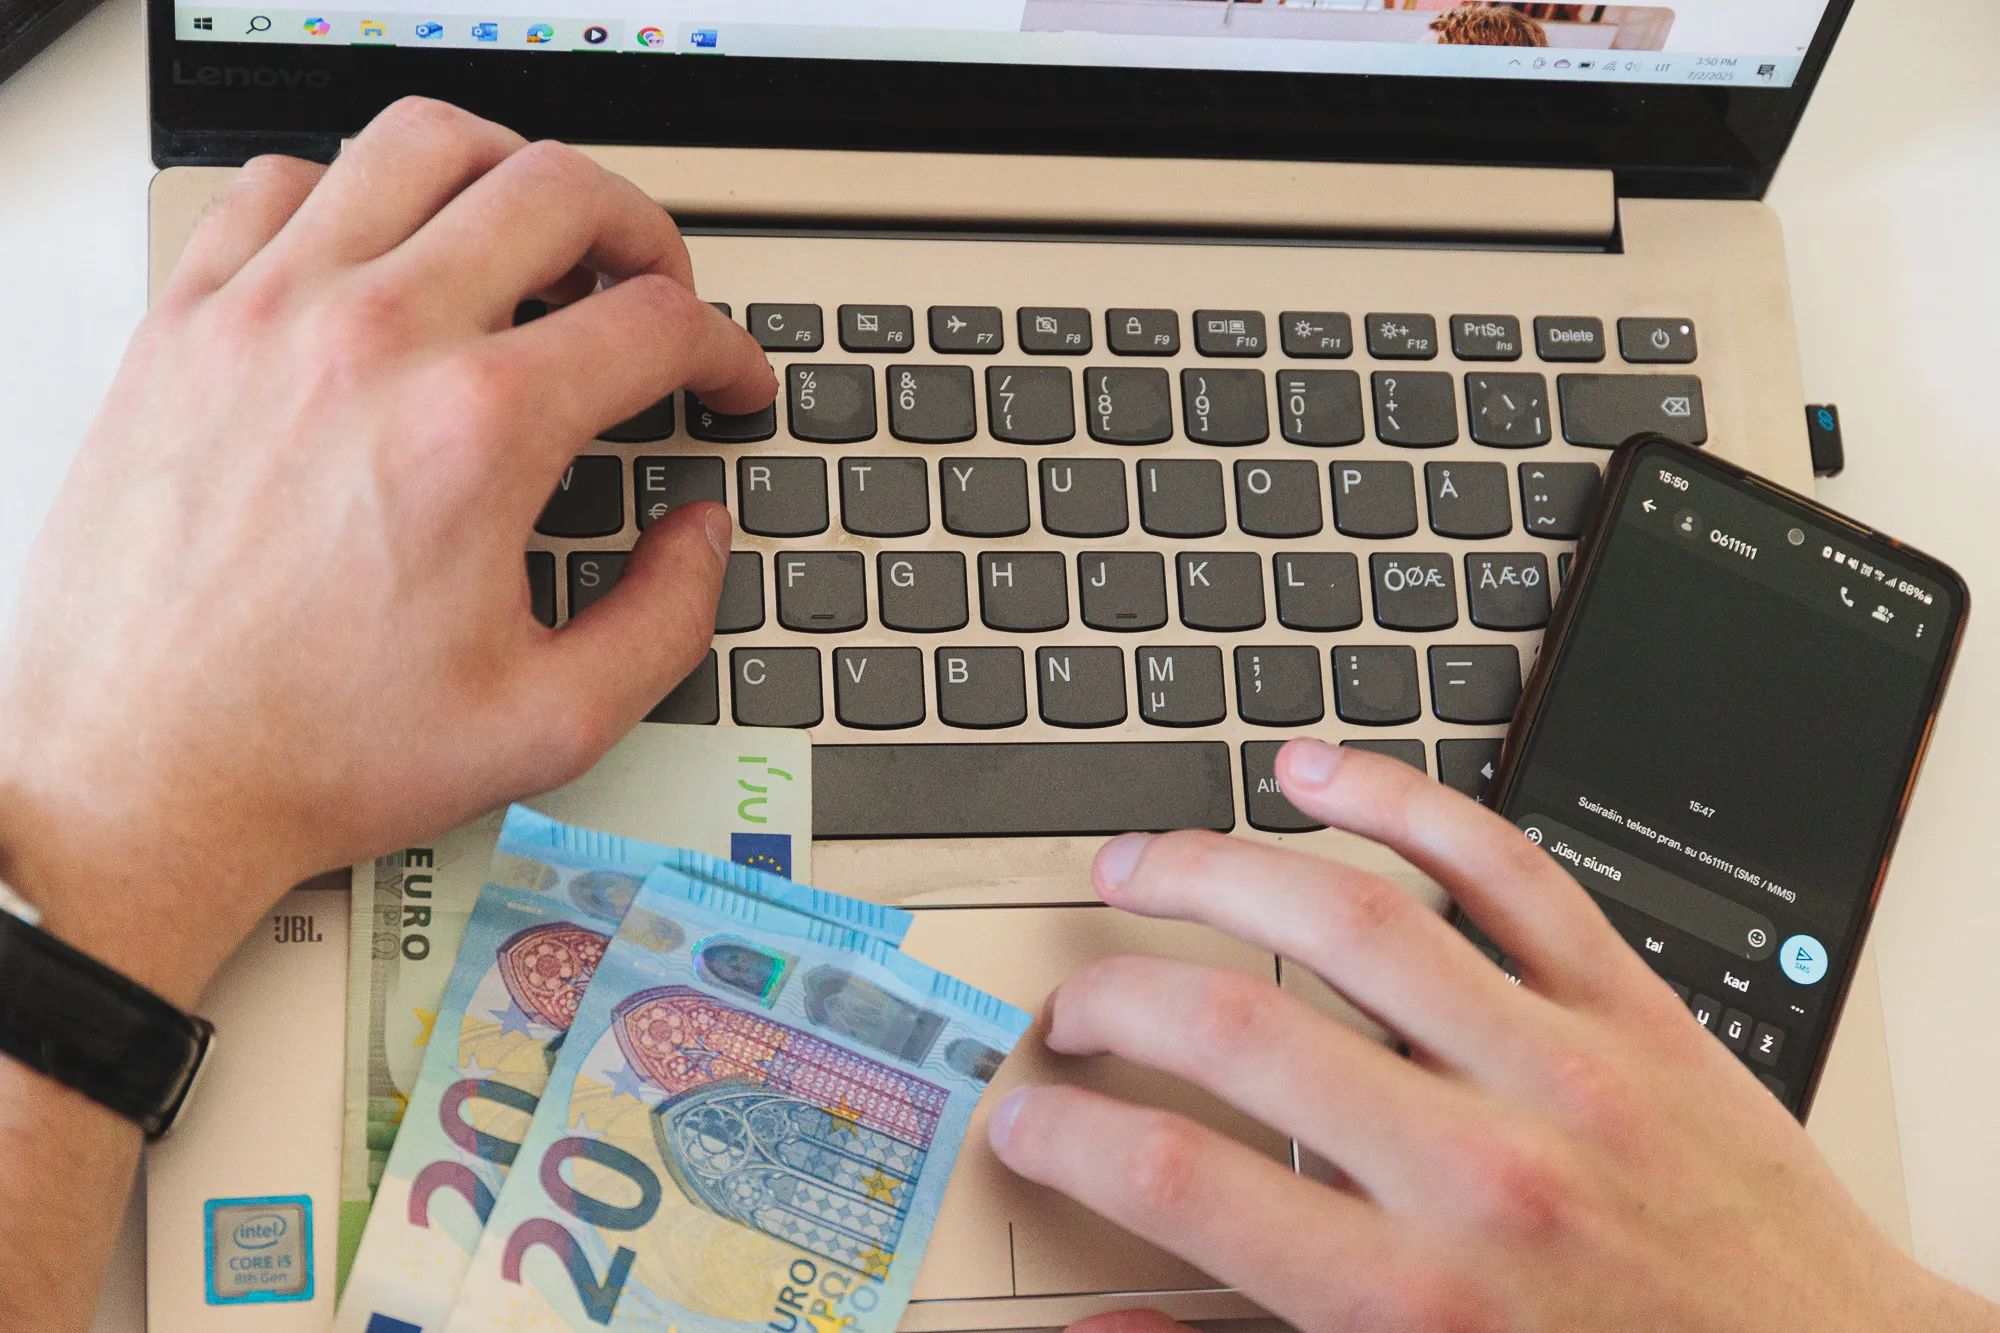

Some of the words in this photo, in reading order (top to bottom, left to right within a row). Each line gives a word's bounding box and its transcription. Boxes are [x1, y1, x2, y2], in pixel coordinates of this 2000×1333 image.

[1695, 57, 1718, 66] 3:50
[1719, 58, 1738, 66] PM
[172, 60, 331, 88] Lenovo
[1687, 71, 1734, 81] 7/2/2025
[795, 330, 811, 342] F5
[886, 330, 903, 343] F6
[976, 332, 994, 344] F7
[1065, 333, 1082, 345] F8
[1154, 334, 1170, 346] F9
[1464, 322, 1505, 337] PrtSc
[1549, 328, 1594, 343] Delete
[1236, 335, 1258, 348] F10
[1320, 337, 1341, 348] F11
[1406, 338, 1428, 350] F12
[1496, 340, 1513, 351] Ins
[799, 390, 816, 410] 5
[899, 389, 915, 410] 6
[999, 392, 1015, 413] 7
[1097, 394, 1113, 415] 8
[1195, 395, 1210, 416] 9
[1290, 395, 1305, 416] 0
[646, 466, 667, 491] E
[749, 466, 772, 492] R
[850, 466, 872, 492] T
[952, 467, 974, 492] Y
[1051, 467, 1072, 493] U
[1247, 468, 1272, 494] O
[1342, 469, 1362, 494] P
[1439, 470, 1459, 498] Å
[1659, 469, 1689, 491] 15:50
[1709, 529, 1758, 560] 0611111
[579, 561, 601, 587] S
[787, 562, 806, 588] F
[890, 561, 915, 587] G
[991, 562, 1013, 587] H
[1091, 562, 1106, 587] J
[1188, 561, 1210, 587] K
[1286, 561, 1305, 587] L
[1898, 580, 1924, 601] 68%
[743, 658, 766, 685] C
[845, 658, 867, 684] V
[947, 658, 969, 683] B
[1048, 657, 1071, 682] N
[1148, 656, 1174, 682] M
[1257, 777, 1281, 793] Alt
[1689, 800, 1715, 818] 15:47
[1550, 840, 1582, 867] Jūsų
[1583, 855, 1622, 882] siunta
[1578, 796, 1624, 825] Susirašin.
[1626, 817, 1657, 839] teksto
[1657, 832, 1683, 853] pran.
[1684, 844, 1699, 858] su
[1699, 851, 1734, 874] 0611111
[1733, 866, 1760, 887] (SMS
[1766, 883, 1797, 904] MMS)
[402, 848, 434, 961] EURO
[273, 915, 322, 944] JBL
[1645, 937, 1664, 953] tai
[1794, 961, 1811, 974] SMS
[1723, 971, 1750, 993] kad
[1728, 1020, 1742, 1039] ū
[1759, 1034, 1774, 1053] ž
[240, 1221, 278, 1239] intel
[501, 1136, 662, 1327] 20
[229, 1255, 273, 1271] CORE
